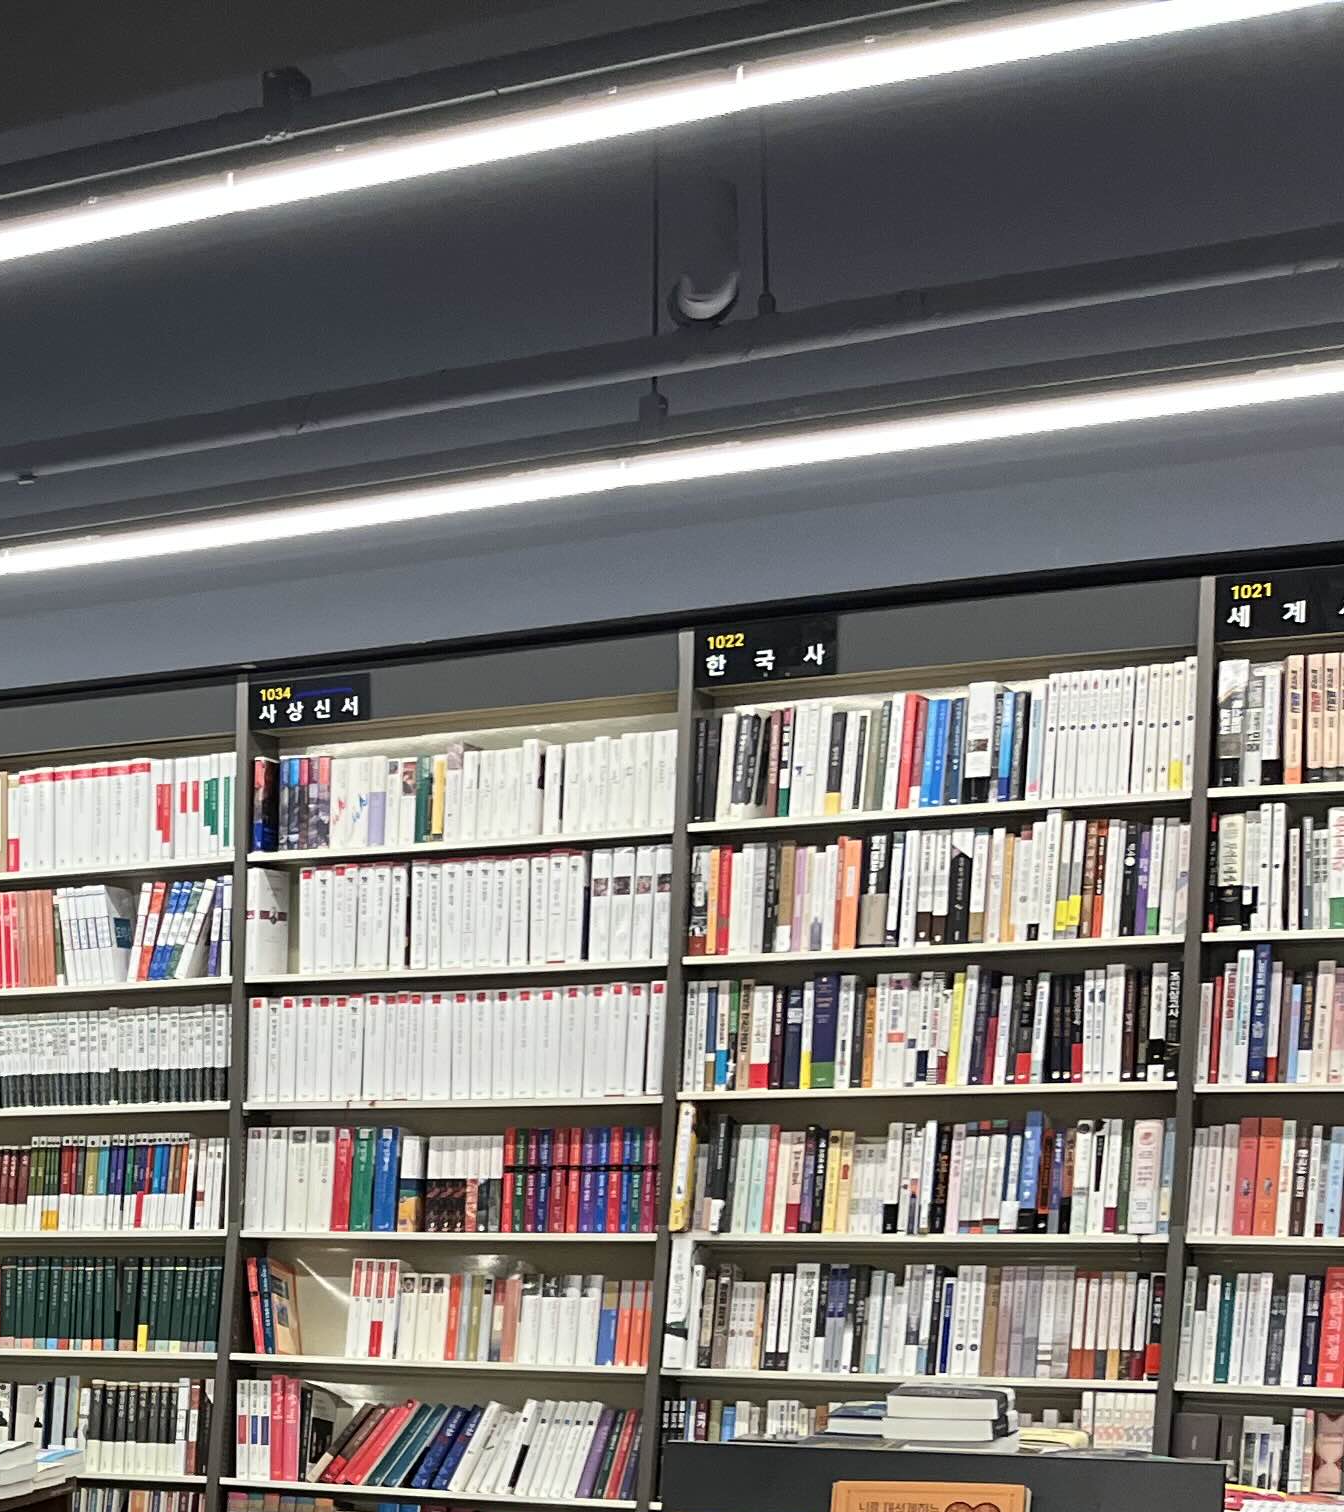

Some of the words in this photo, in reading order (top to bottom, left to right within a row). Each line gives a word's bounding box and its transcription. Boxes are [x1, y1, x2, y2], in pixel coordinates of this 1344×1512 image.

[1230, 583, 1273, 601] 1021
[1226, 599, 1344, 629] 세계
[706, 633, 745, 650] 1022
[259, 687, 291, 702] 1034
[259, 695, 360, 724] 사상신서
[1295, 1149, 1308, 1174] 한국사
